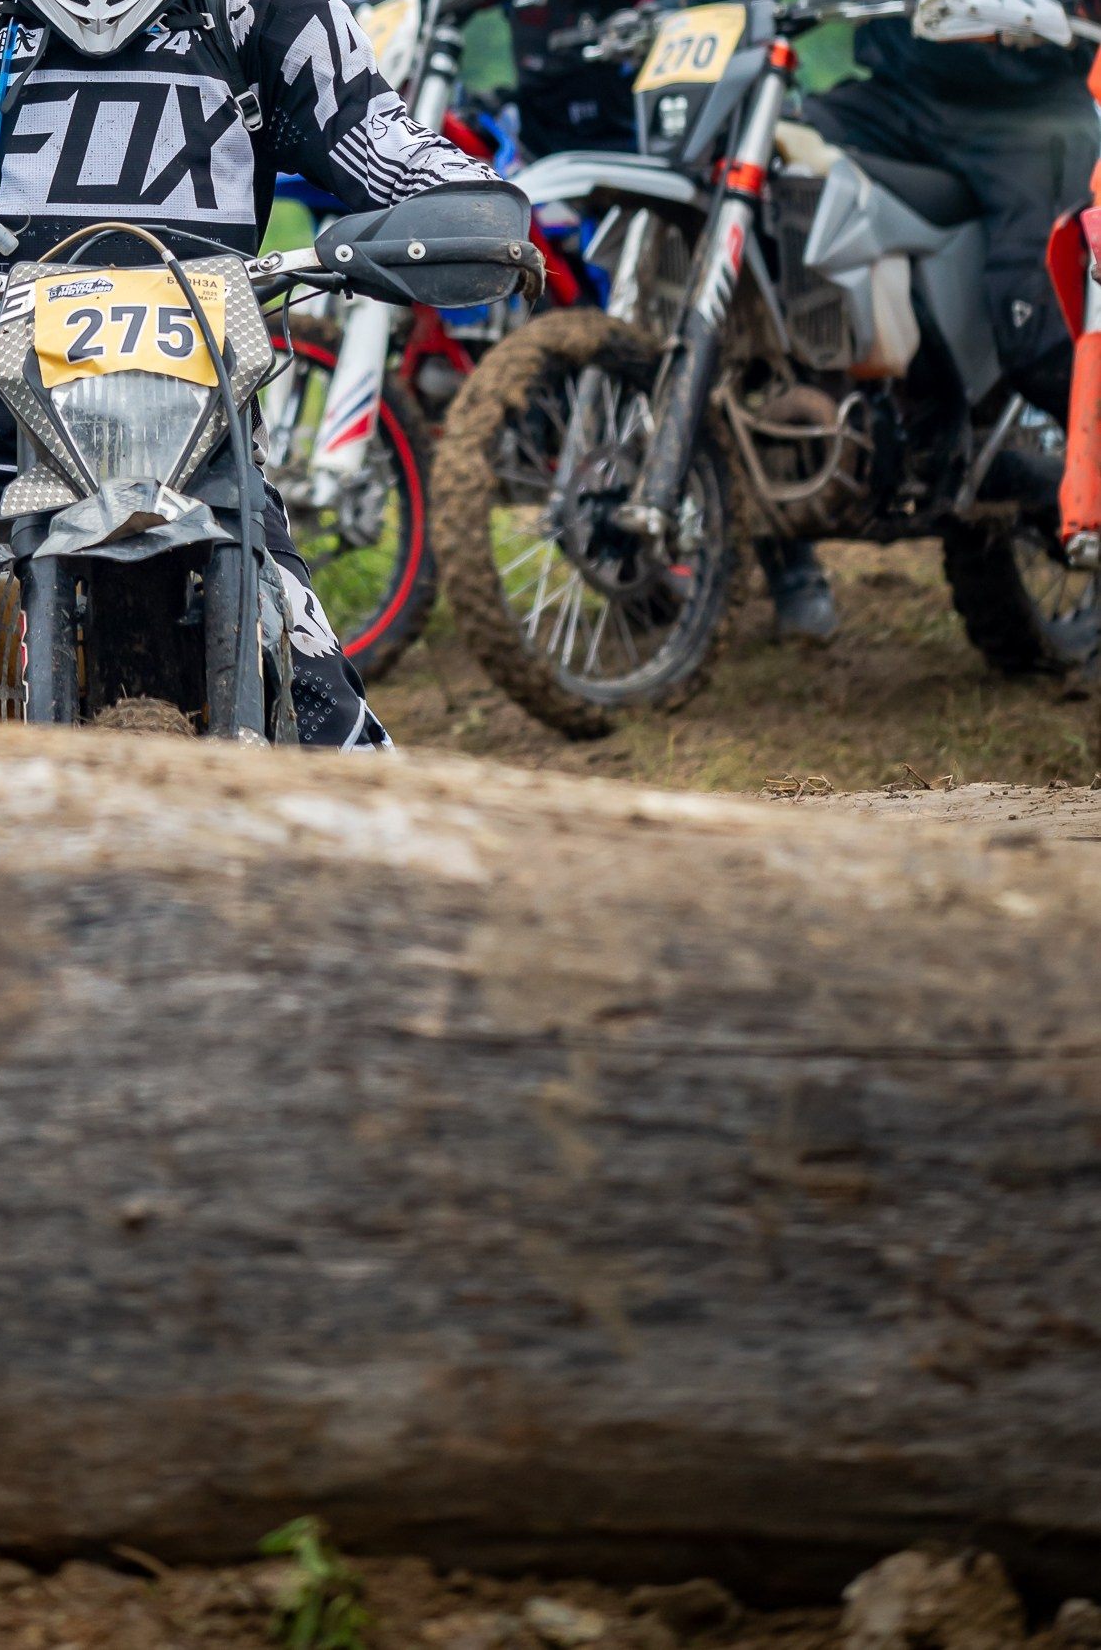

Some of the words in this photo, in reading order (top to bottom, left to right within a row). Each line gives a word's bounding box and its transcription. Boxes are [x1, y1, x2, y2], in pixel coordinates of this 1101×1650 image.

[653, 34, 719, 77] 270
[167, 276, 218, 289] БНЗА
[65, 305, 196, 363] 275
